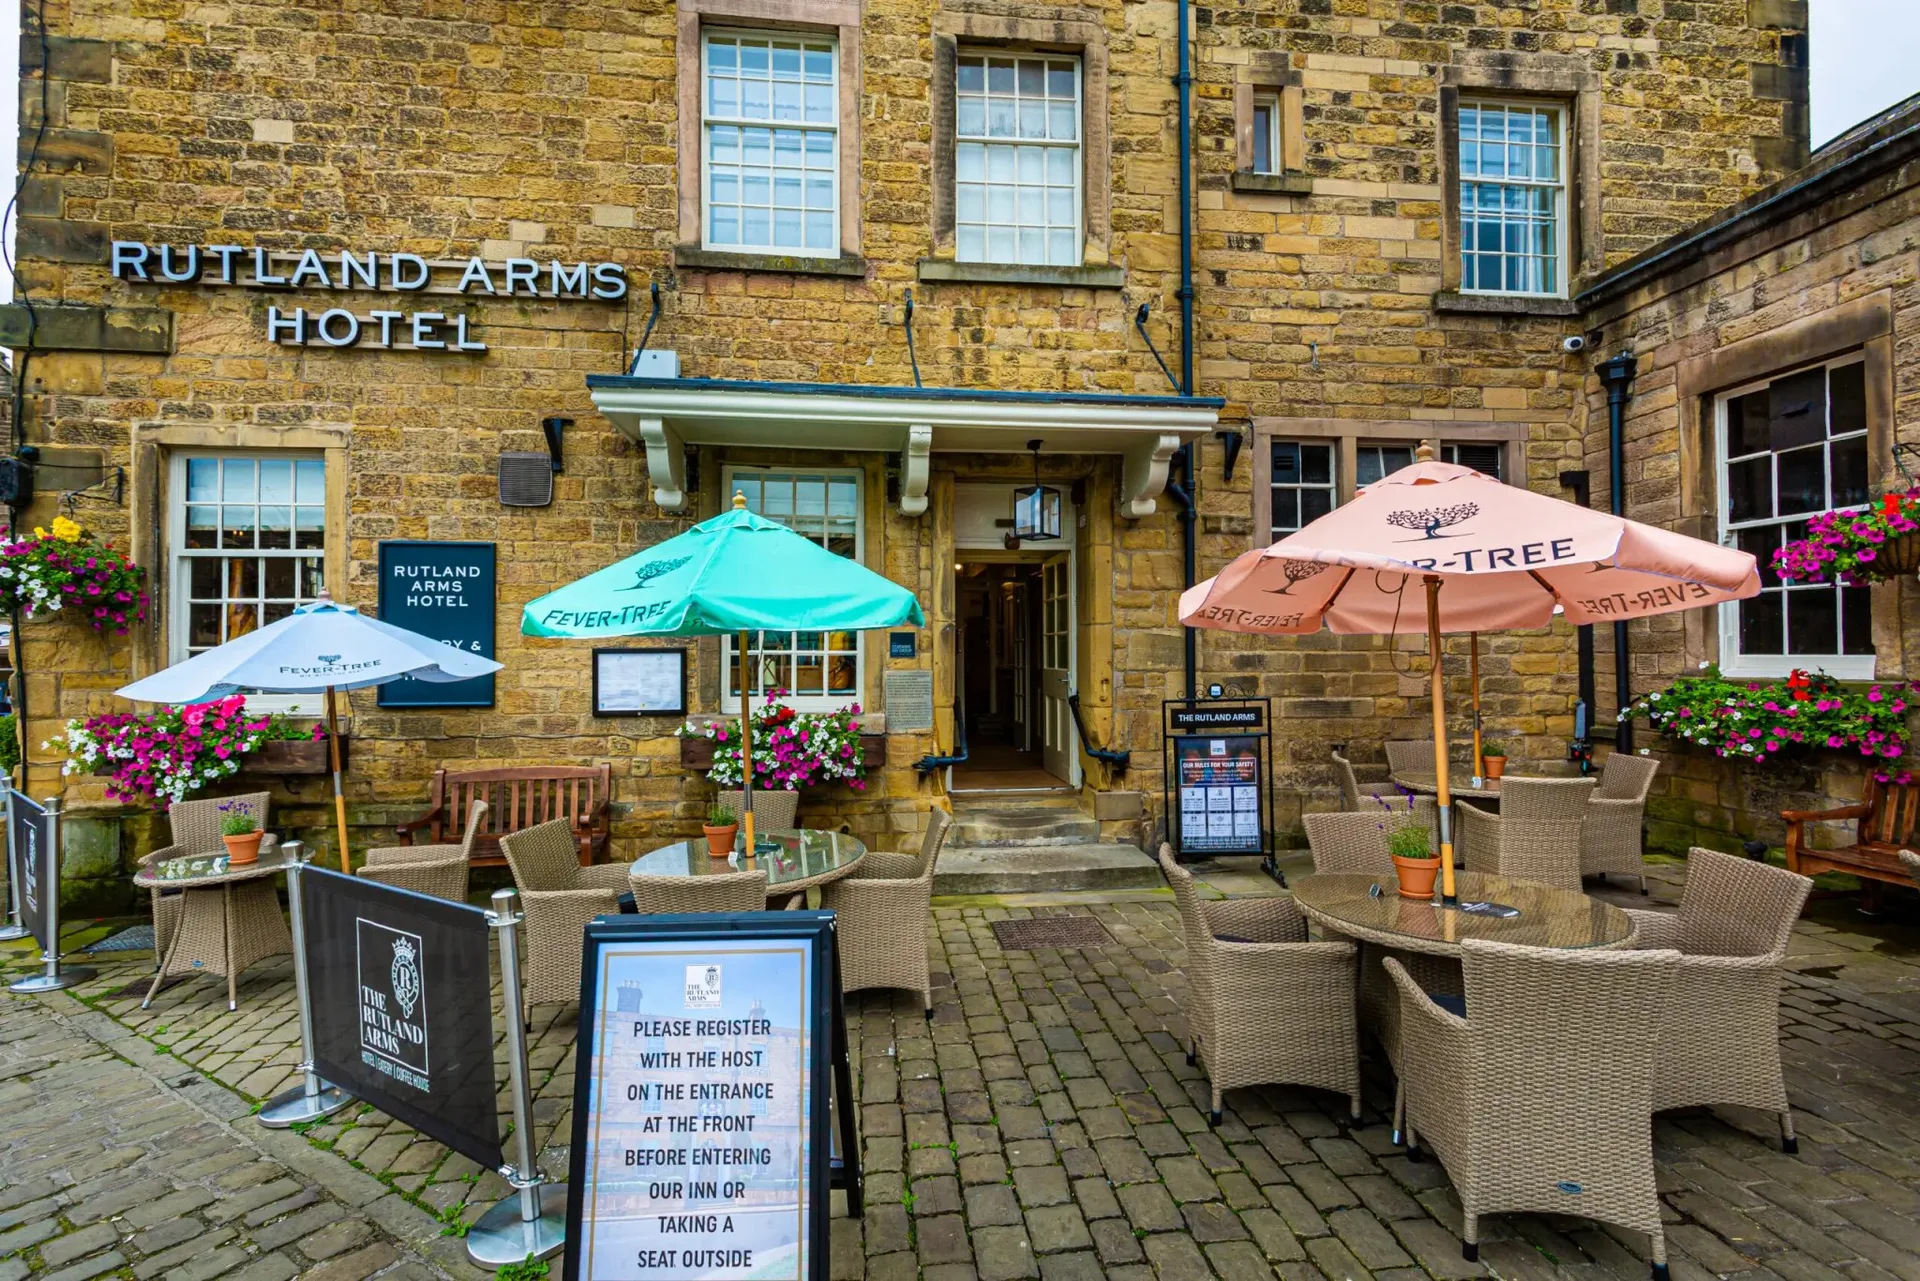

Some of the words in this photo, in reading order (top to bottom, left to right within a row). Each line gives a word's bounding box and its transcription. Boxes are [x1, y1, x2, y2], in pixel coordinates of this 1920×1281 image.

[111, 241, 430, 290] RUTLAND
[457, 256, 627, 299] ARMS
[267, 306, 488, 351] HOTEL
[1313, 538, 1576, 572] R-TREE
[394, 566, 481, 577] RUTLAND
[411, 581, 463, 592] ARMS
[407, 595, 469, 607] HOTEL
[542, 600, 672, 628] FEVER-TREE
[470, 640, 482, 651] &
[280, 659, 382, 674] FEVER-TREE
[1178, 714, 1194, 722] THE
[1194, 713, 1232, 722] RUTLAND
[1232, 713, 1256, 721] ARMS
[400, 966, 412, 990] R
[362, 985, 387, 1012] THE
[363, 1005, 424, 1045] RUTLAND
[633, 1020, 691, 1038] PLEASE
[696, 1019, 771, 1036] REGISTER
[364, 1025, 400, 1055] ARMS
[640, 1051, 681, 1069] WITH
[687, 1051, 717, 1068] THE
[722, 1050, 763, 1067] HOST
[396, 1066, 413, 1086] COFFEE
[627, 1084, 649, 1101] ON
[655, 1083, 685, 1100] THE
[690, 1082, 774, 1100] ENTRANCE
[643, 1116, 662, 1133] AT
[668, 1115, 698, 1132] THE
[702, 1114, 755, 1132] FRONT
[625, 1148, 687, 1166] BEFORE
[692, 1147, 771, 1165] ENTERING
[649, 1182, 683, 1199] OUR
[688, 1182, 718, 1199] INN
[722, 1181, 745, 1199] OR
[658, 1216, 717, 1233] TAKING
[722, 1216, 734, 1233] A
[637, 1250, 676, 1268] SEAT
[682, 1250, 753, 1268] OUTSIDE
